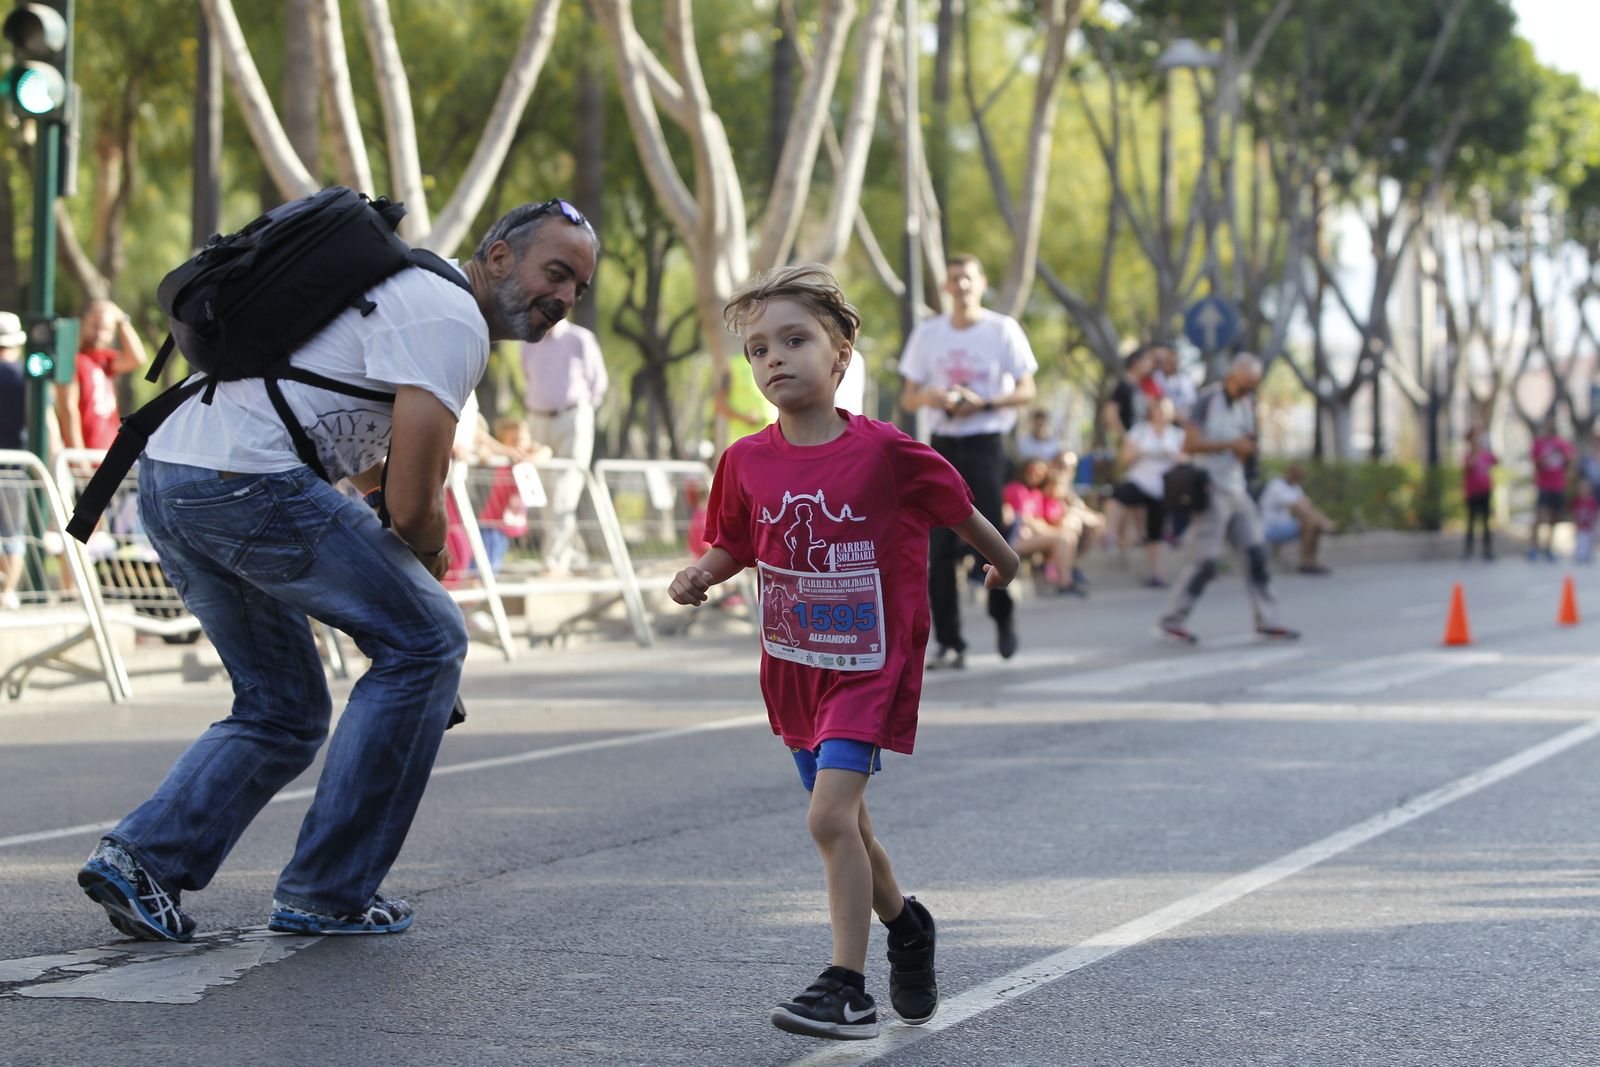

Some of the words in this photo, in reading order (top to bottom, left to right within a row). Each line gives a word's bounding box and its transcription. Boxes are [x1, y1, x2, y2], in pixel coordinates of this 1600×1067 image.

[823, 543, 838, 572] 4
[837, 540, 874, 552] CARRERA
[837, 551, 875, 562] SOLIDARIA
[796, 577, 803, 594] 4
[802, 578, 837, 588] CARRERA
[838, 577, 874, 588] SOLIDARIA
[792, 602, 877, 632] 1595
[808, 632, 858, 644] ALEJANDRO
